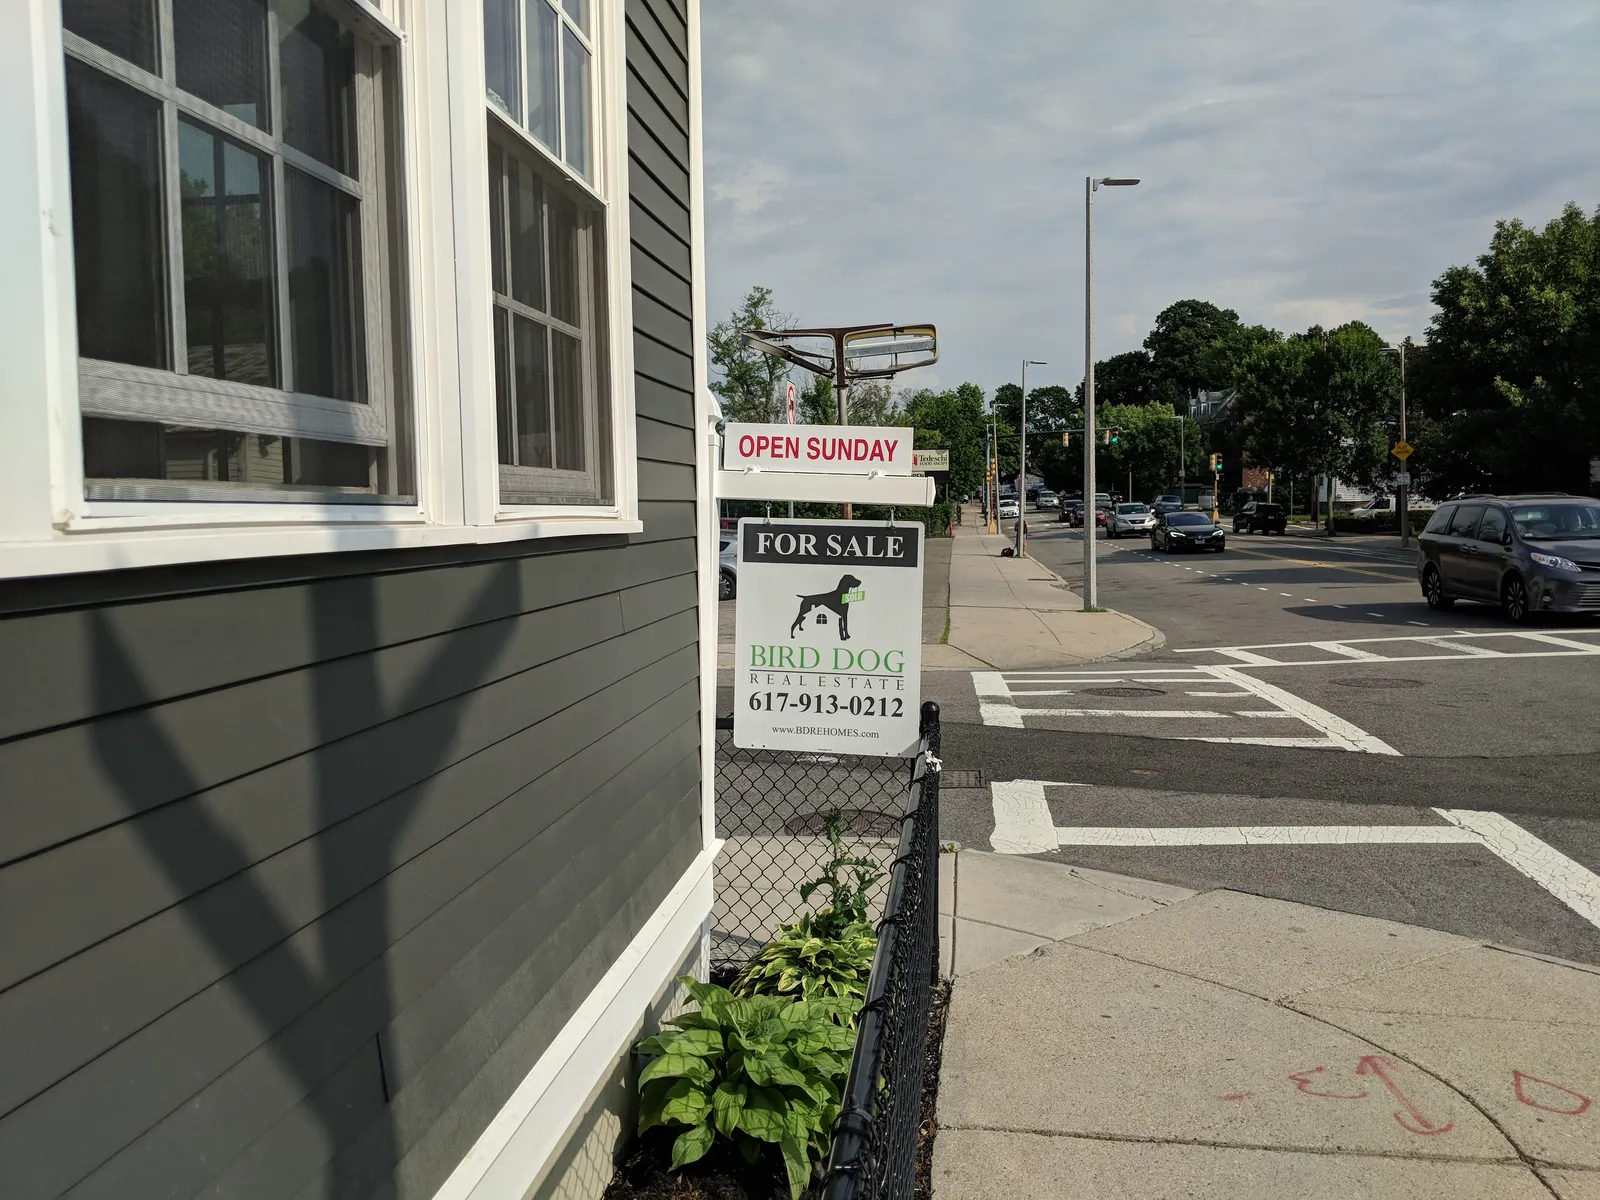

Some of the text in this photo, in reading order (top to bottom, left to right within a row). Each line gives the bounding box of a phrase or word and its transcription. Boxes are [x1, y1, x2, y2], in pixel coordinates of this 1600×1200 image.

[738, 434, 898, 462] OPEN SUNDAY
[756, 532, 904, 558] FOR SALE
[845, 591, 863, 603] SOLD
[750, 645, 905, 673] BIRD DOG
[750, 673, 905, 691] REAL ESTATE
[749, 691, 904, 718] 617-913-0212
[771, 725, 880, 739] www.BDREHOMES.com
